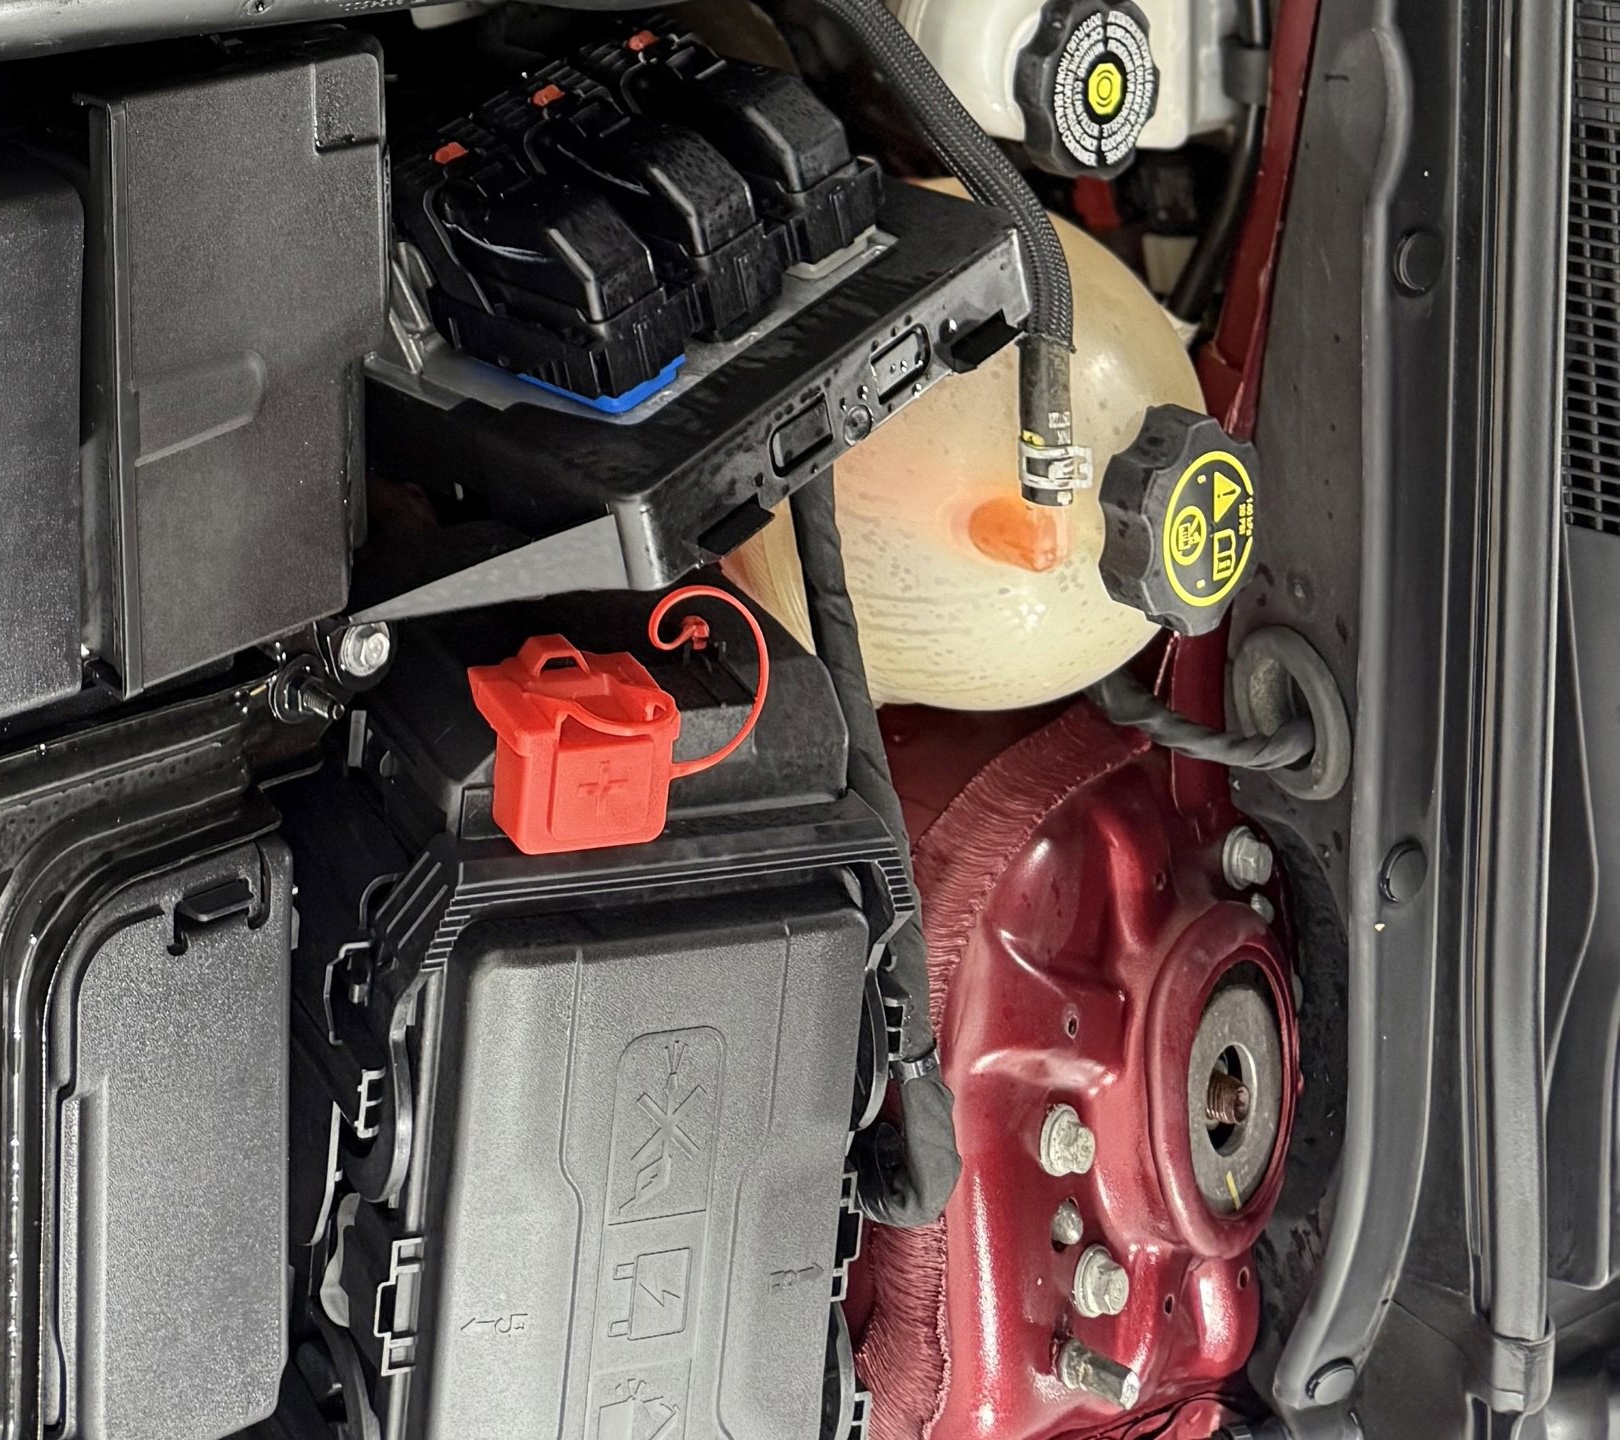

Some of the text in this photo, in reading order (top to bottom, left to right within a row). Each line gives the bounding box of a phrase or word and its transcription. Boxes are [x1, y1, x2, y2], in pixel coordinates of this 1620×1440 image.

[1054, 52, 1071, 84] FROM
[1053, 93, 1069, 134] SEALED
[1073, 80, 1088, 116] CLEAN
